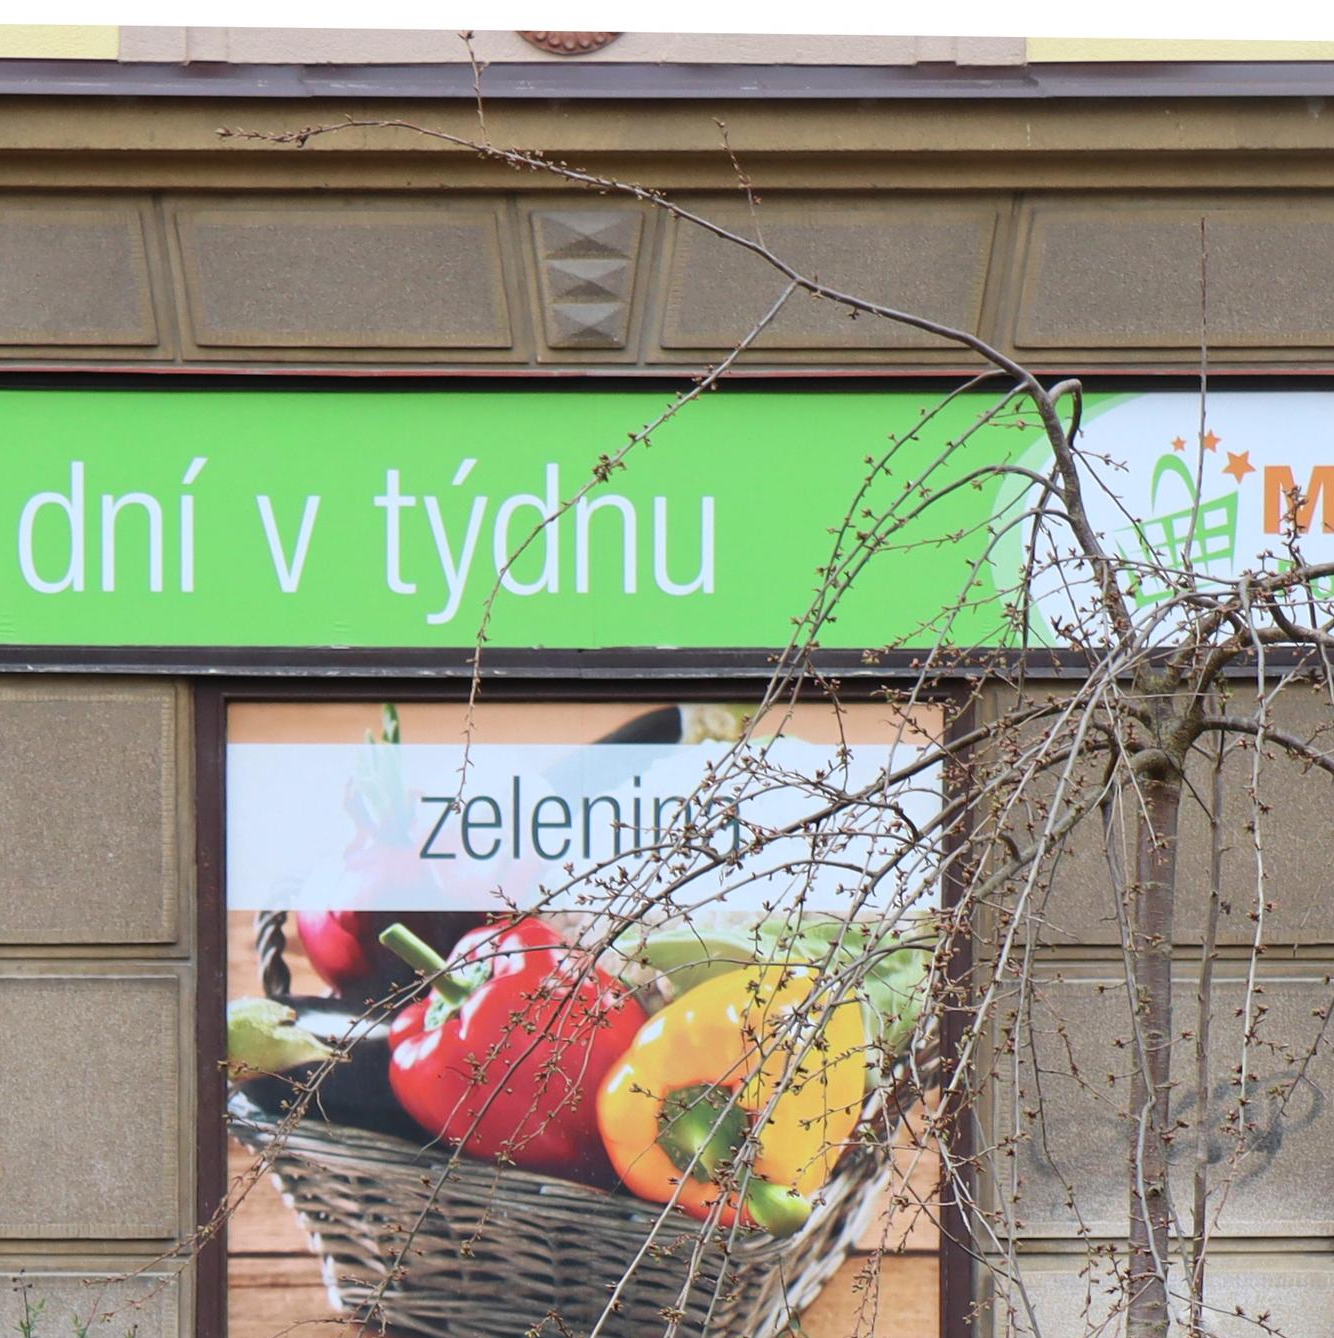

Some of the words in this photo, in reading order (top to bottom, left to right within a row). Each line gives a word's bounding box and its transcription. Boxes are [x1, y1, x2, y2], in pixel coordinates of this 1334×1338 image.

[17, 456, 208, 594] dní
[255, 494, 321, 593] v
[373, 457, 716, 625] týdnu
[419, 775, 746, 861] zelenina
